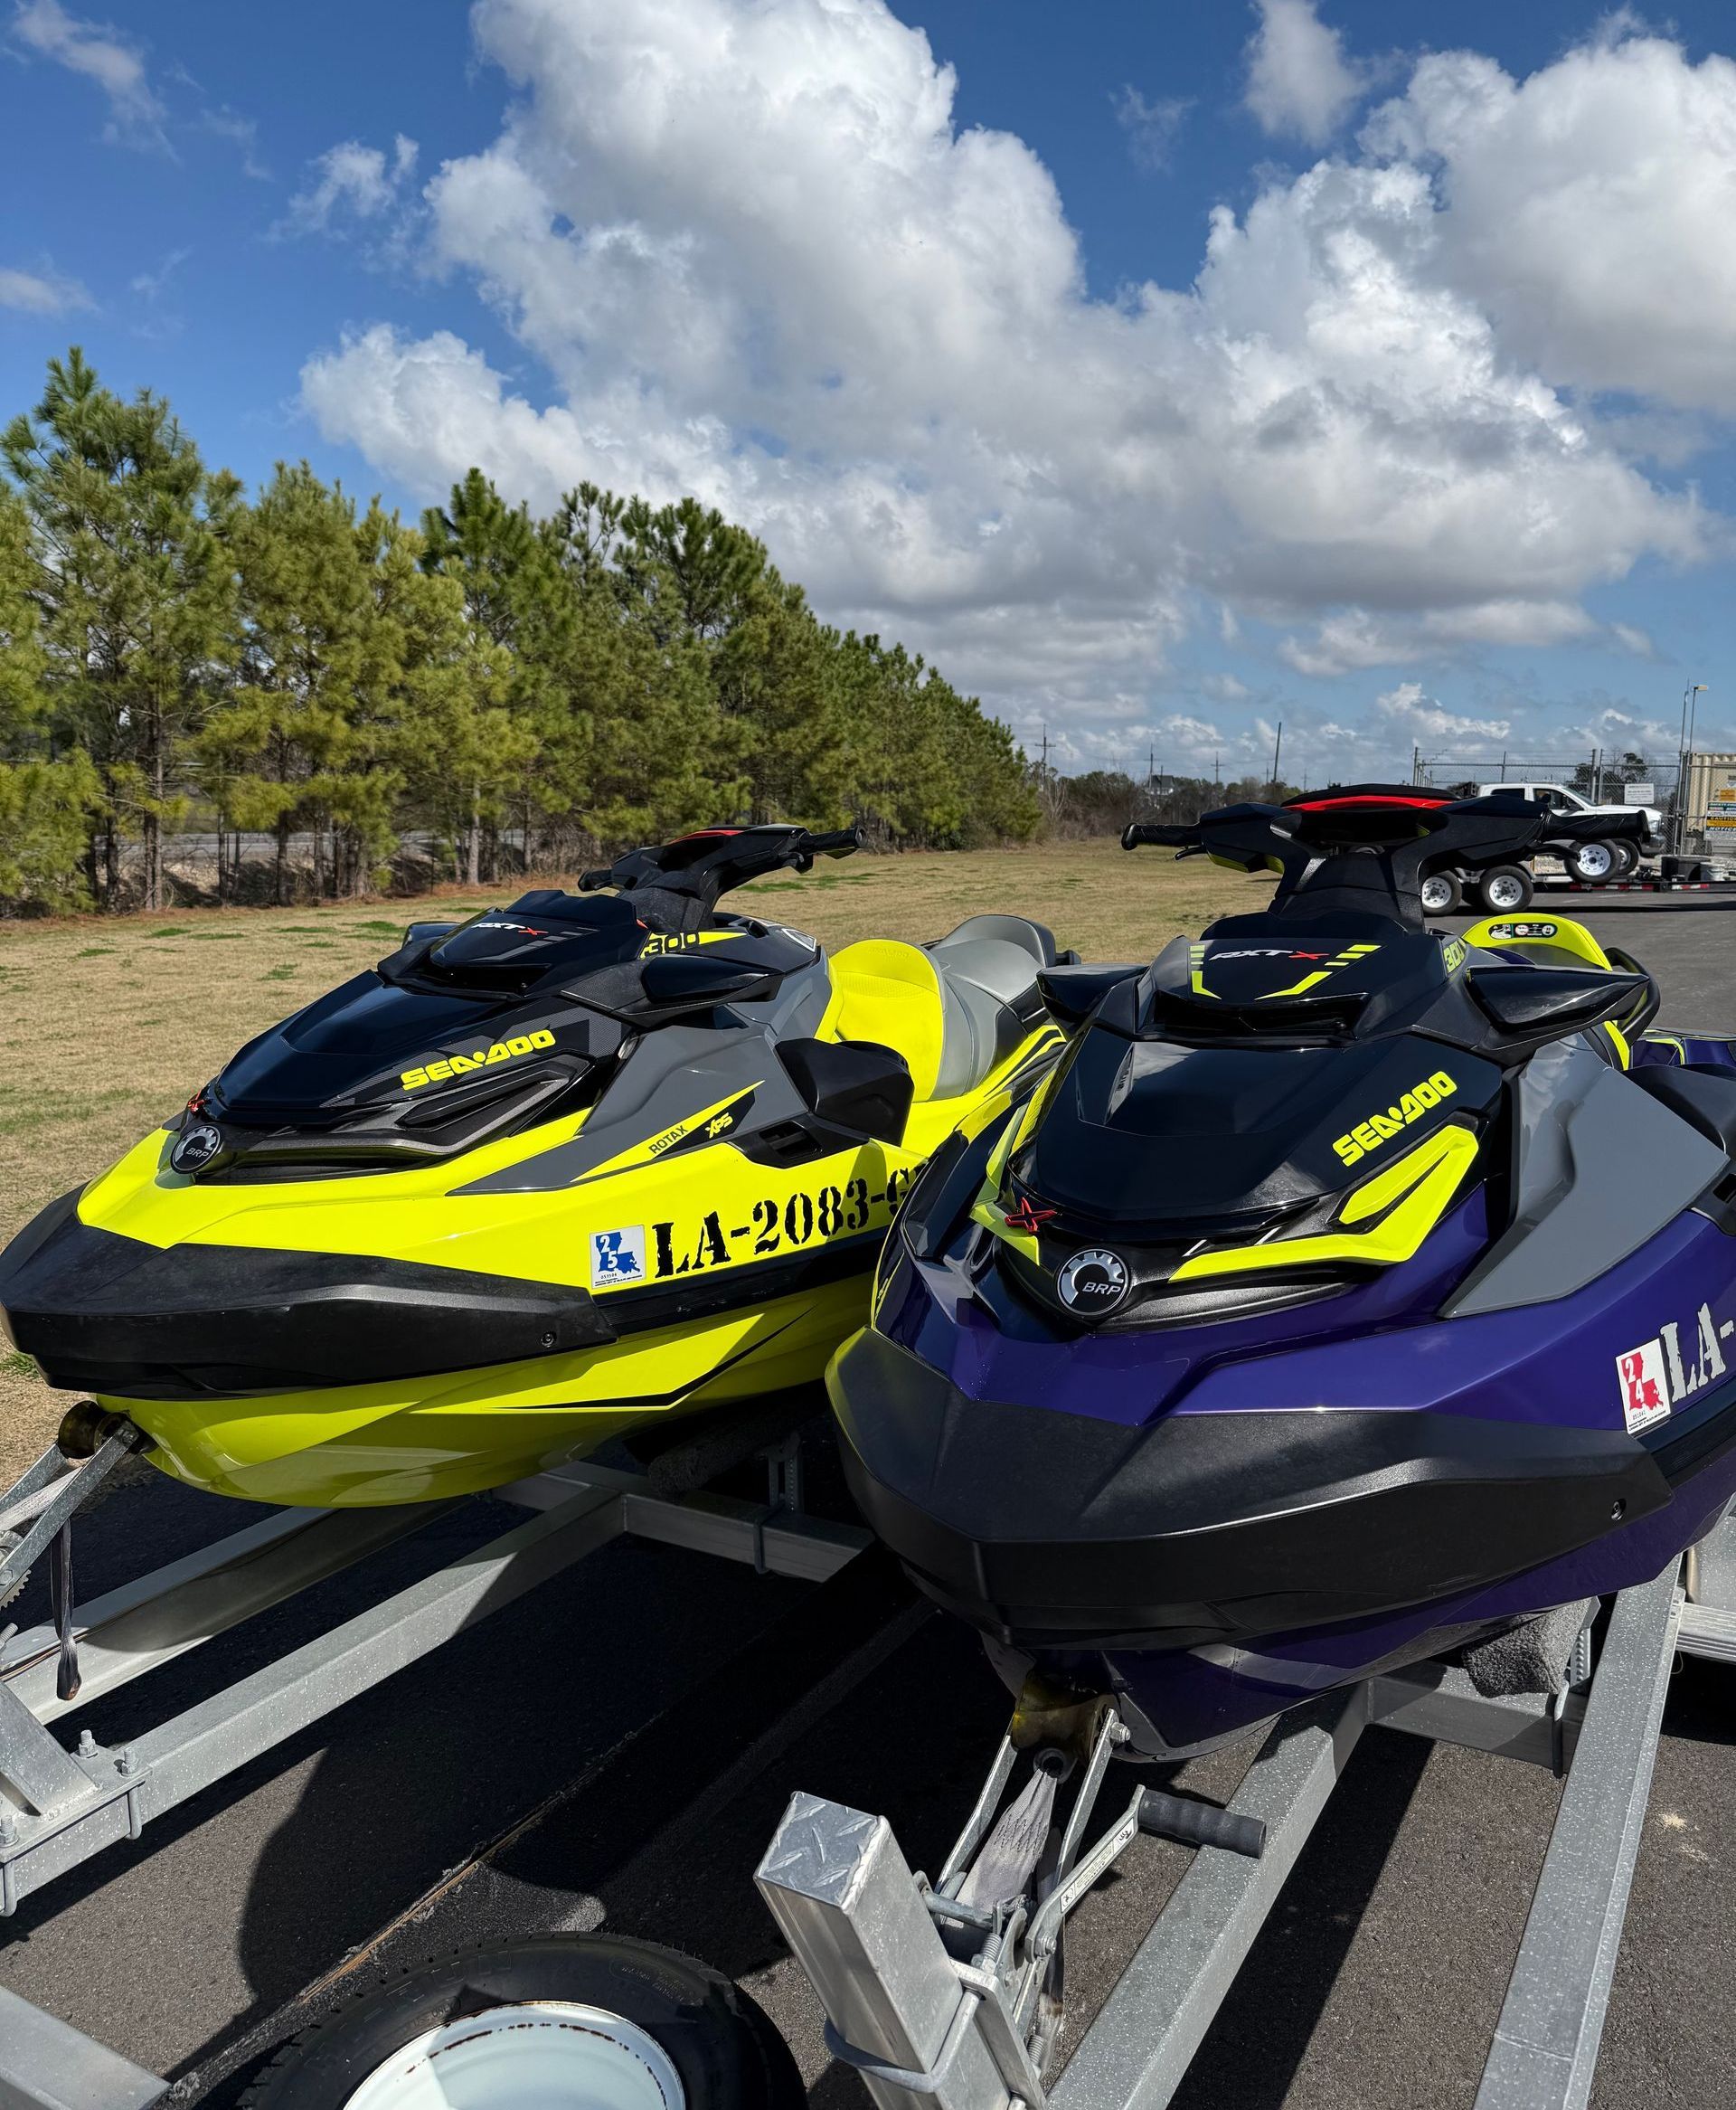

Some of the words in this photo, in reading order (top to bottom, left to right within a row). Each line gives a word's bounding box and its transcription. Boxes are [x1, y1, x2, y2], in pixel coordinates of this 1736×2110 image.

[644, 932, 699, 956] 300
[1208, 949, 1293, 960] RXT
[704, 1112, 734, 1140] XPS
[647, 1124, 689, 1155] ROTAX
[185, 1146, 210, 1159] BRP
[651, 1163, 928, 1279] LA-2083-G
[1081, 1281, 1122, 1296] BRP
